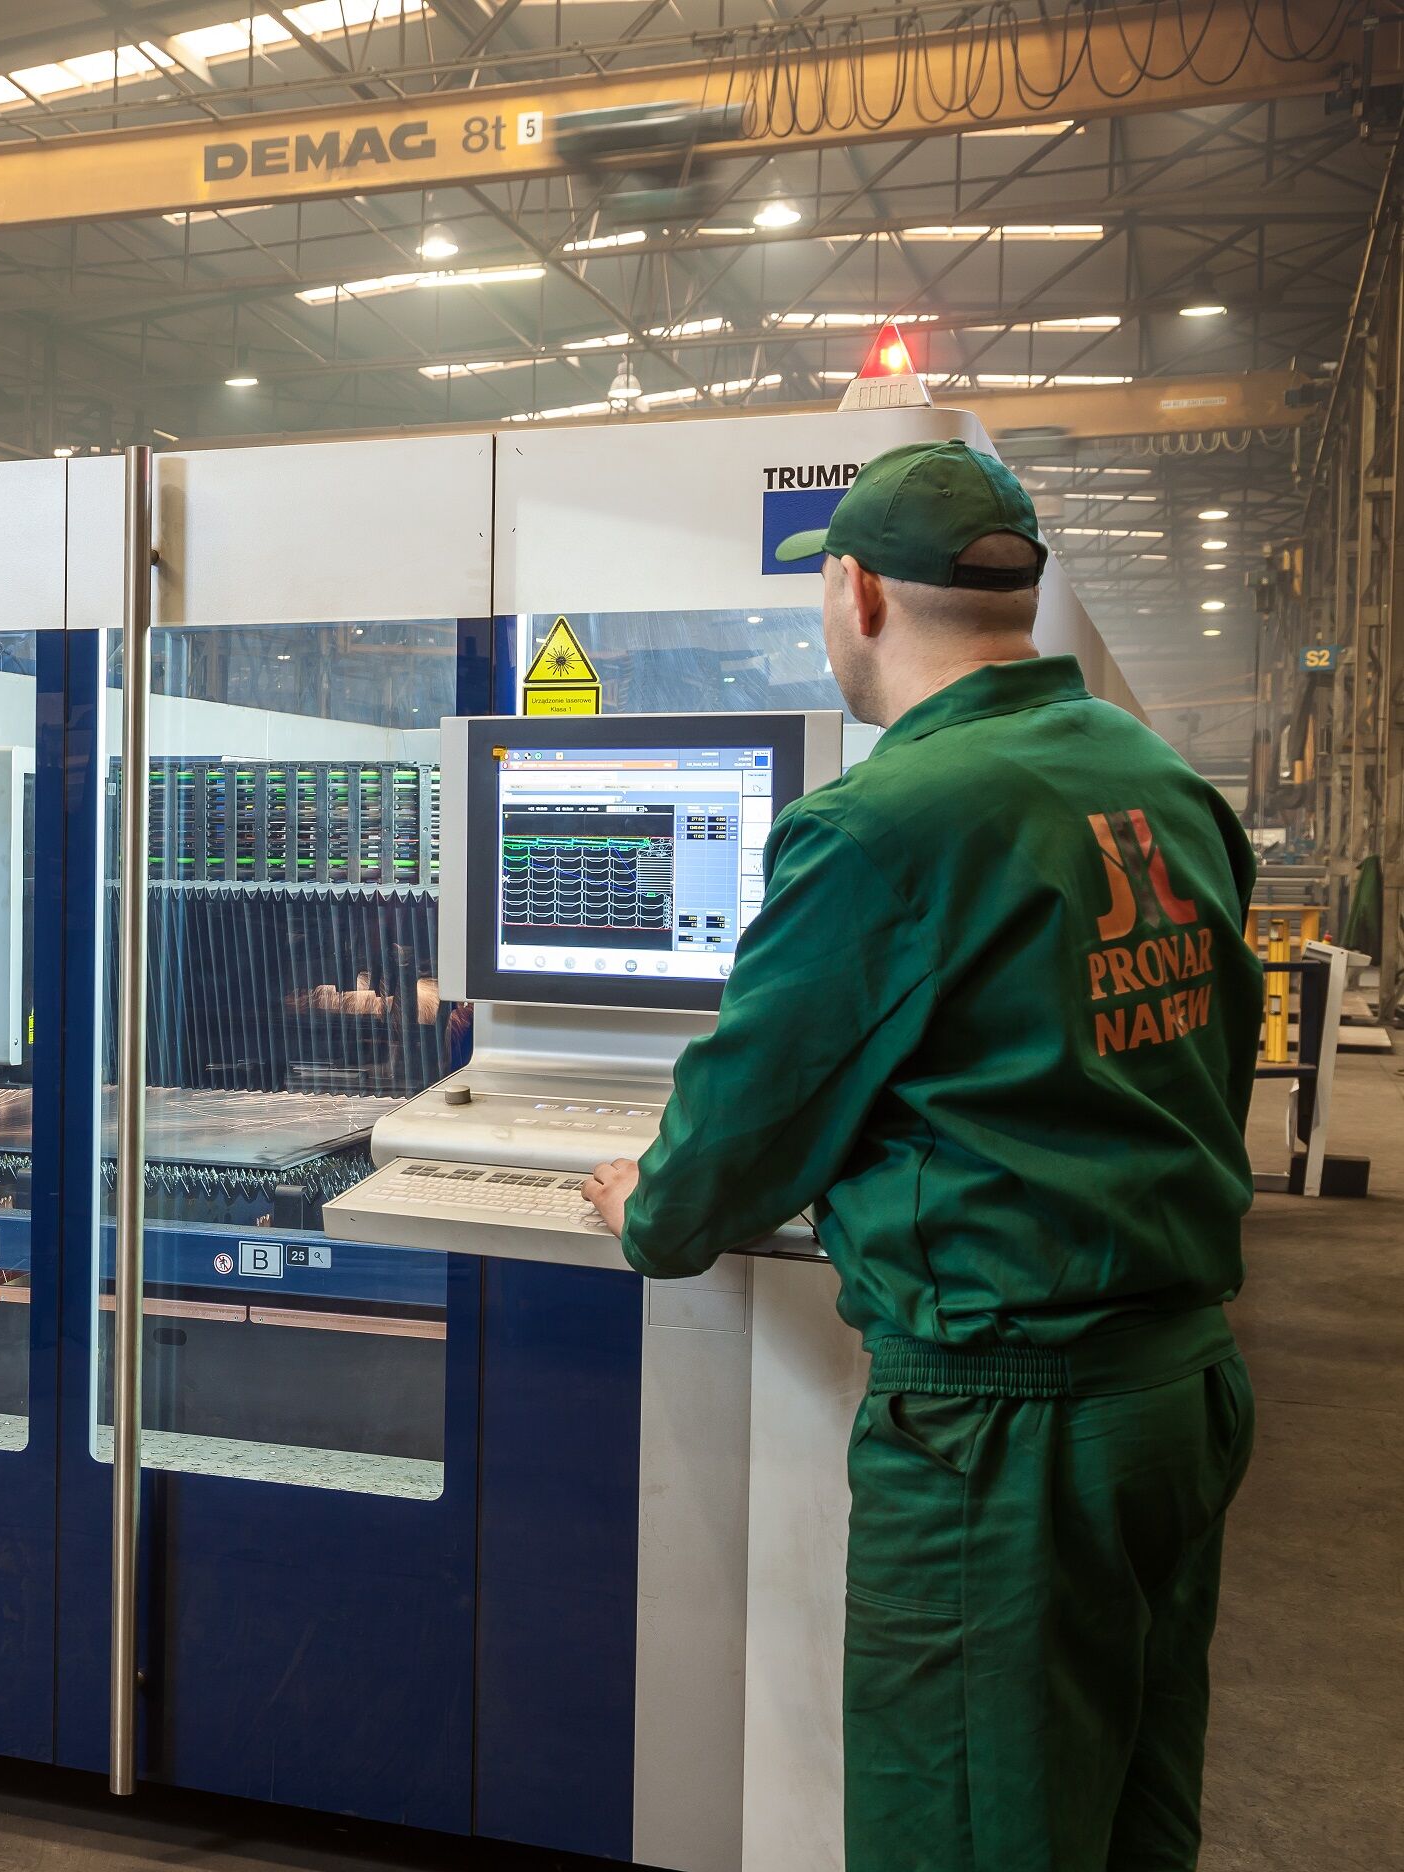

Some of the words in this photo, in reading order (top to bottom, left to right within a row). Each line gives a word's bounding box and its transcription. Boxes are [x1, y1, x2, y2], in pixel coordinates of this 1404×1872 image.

[525, 117, 536, 138] 5
[203, 120, 437, 182] DEMAG
[462, 114, 506, 154] 8t
[763, 463, 867, 489] TRUMP
[1305, 649, 1330, 667] S2
[1087, 928, 1213, 1000] PRONAR
[254, 1249, 268, 1270] B
[291, 1250, 305, 1261] 25
